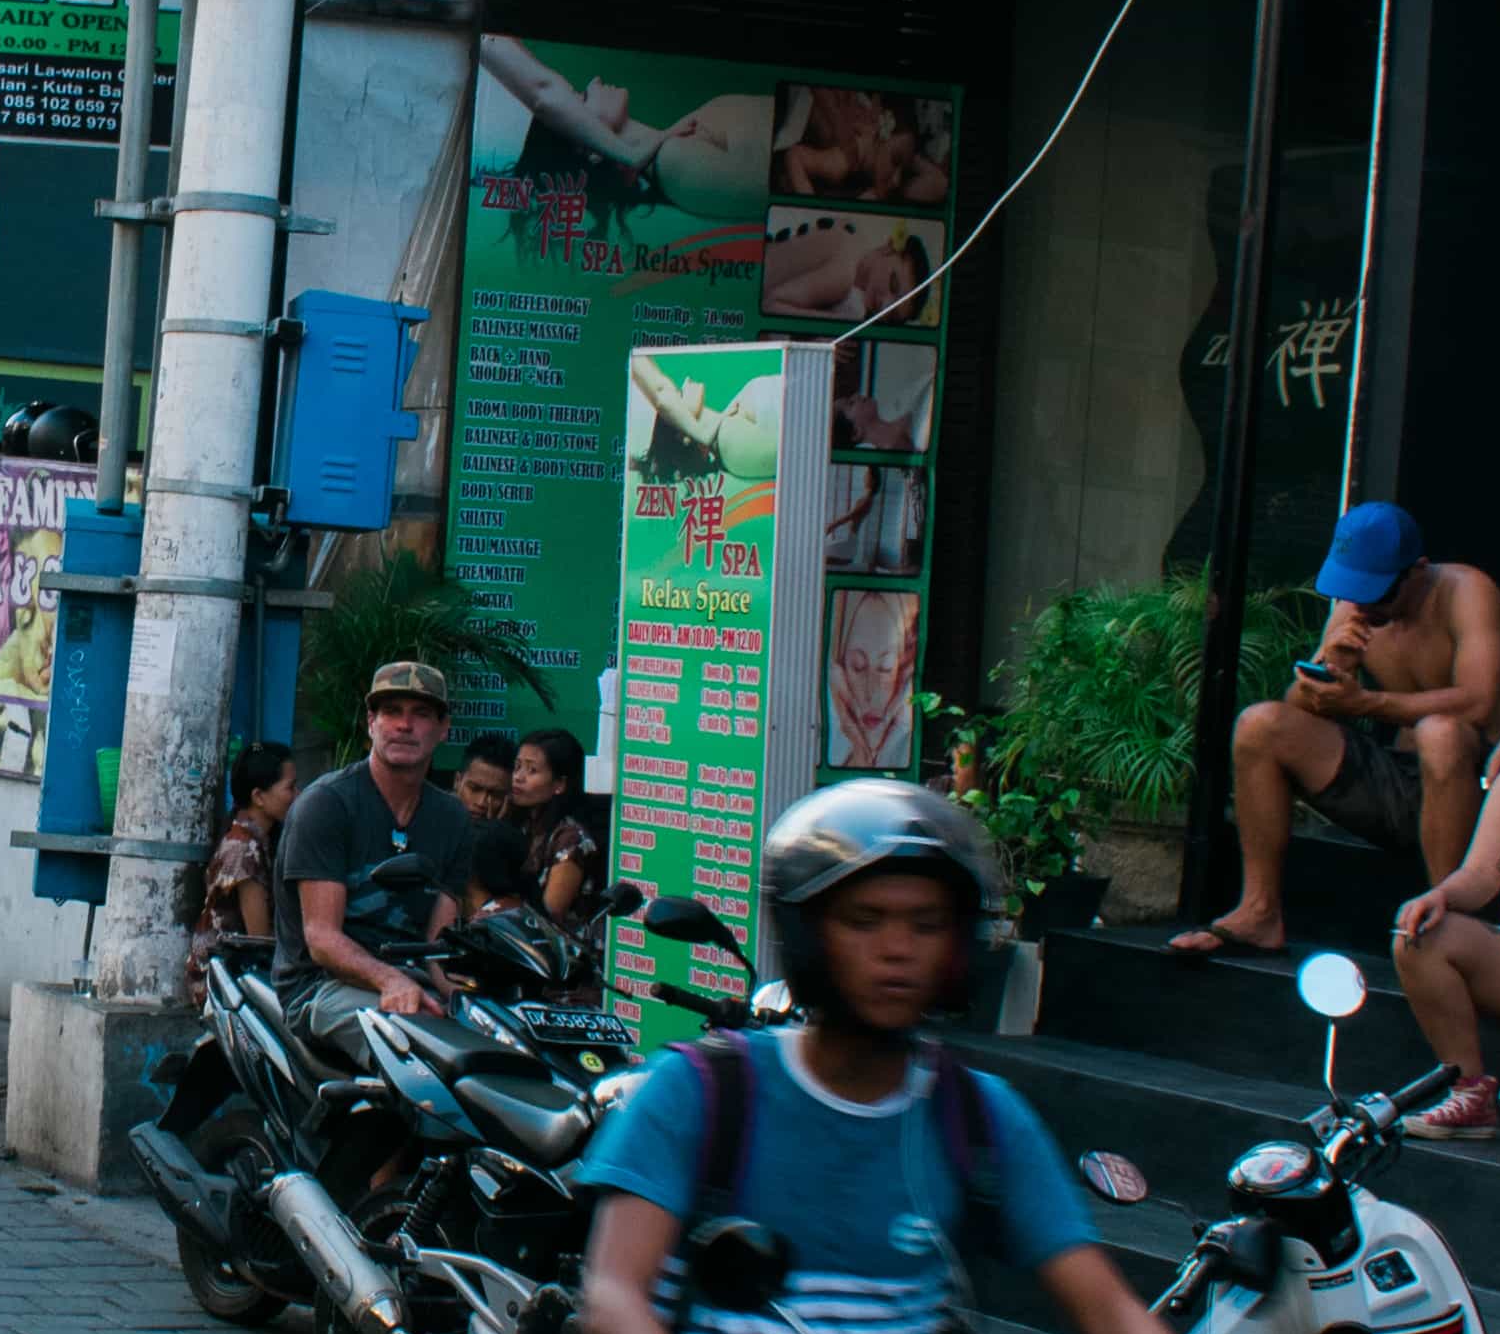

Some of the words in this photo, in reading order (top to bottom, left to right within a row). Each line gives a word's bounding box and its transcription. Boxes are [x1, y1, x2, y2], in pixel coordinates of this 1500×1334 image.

[62, 13, 130, 33] OPEN
[68, 38, 100, 53] PM
[42, 80, 83, 97] Kuta
[4, 93, 35, 109] 085
[41, 96, 70, 111] 102
[75, 98, 105, 114] 659
[16, 112, 46, 126] 861
[51, 114, 81, 128] 902
[87, 115, 117, 130] 979
[481, 177, 535, 209] ZEN
[580, 241, 625, 275] SPA
[633, 244, 693, 274] Relax
[700, 249, 755, 285] Space
[473, 290, 505, 309] FOOT
[547, 404, 602, 426] THERAPY
[534, 430, 561, 451] HOT
[635, 485, 678, 519] ZEN
[721, 542, 763, 579] SPA
[640, 578, 692, 609] Relax
[695, 580, 752, 622] Space
